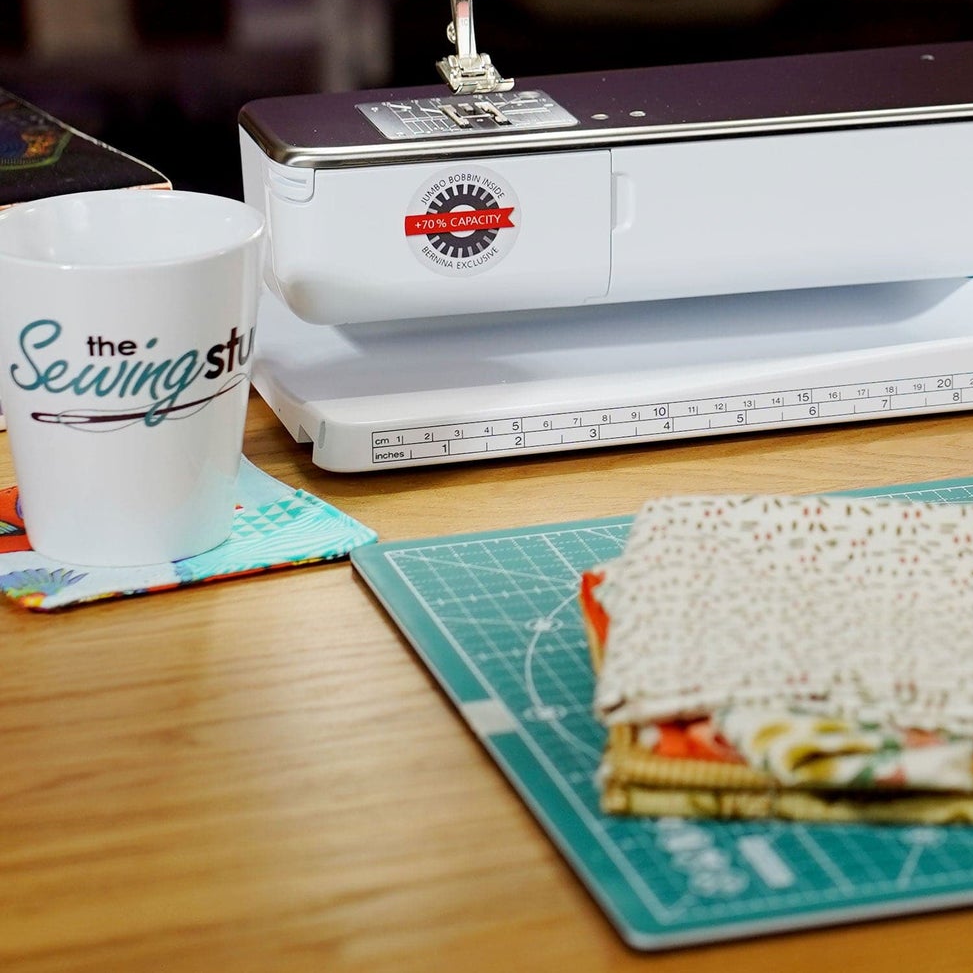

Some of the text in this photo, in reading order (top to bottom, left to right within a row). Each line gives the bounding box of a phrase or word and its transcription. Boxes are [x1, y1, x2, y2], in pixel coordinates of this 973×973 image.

[420, 173, 506, 205] JUMBO BOBBIN INSIDE
[450, 214, 502, 227] CAPACITY
[421, 246, 500, 269] BERNINA EXCLUSIVE
[87, 335, 138, 356] the
[10, 319, 205, 427] Sewing
[512, 421, 520, 431] 5
[543, 420, 549, 428] 6
[653, 407, 666, 416] 10
[743, 400, 752, 408] 13
[771, 397, 780, 405] 14
[797, 392, 810, 402] 15
[885, 386, 894, 394] 18
[913, 383, 922, 391] 19
[936, 378, 952, 388] 20
[375, 451, 405, 460] inches
[442, 444, 447, 453] 1
[515, 436, 522, 446] 2
[589, 428, 597, 438] 3
[663, 421, 670, 430] 4
[736, 413, 744, 423] 5
[808, 406, 817, 416] 6
[882, 399, 888, 408] 7
[952, 392, 960, 401] 8
